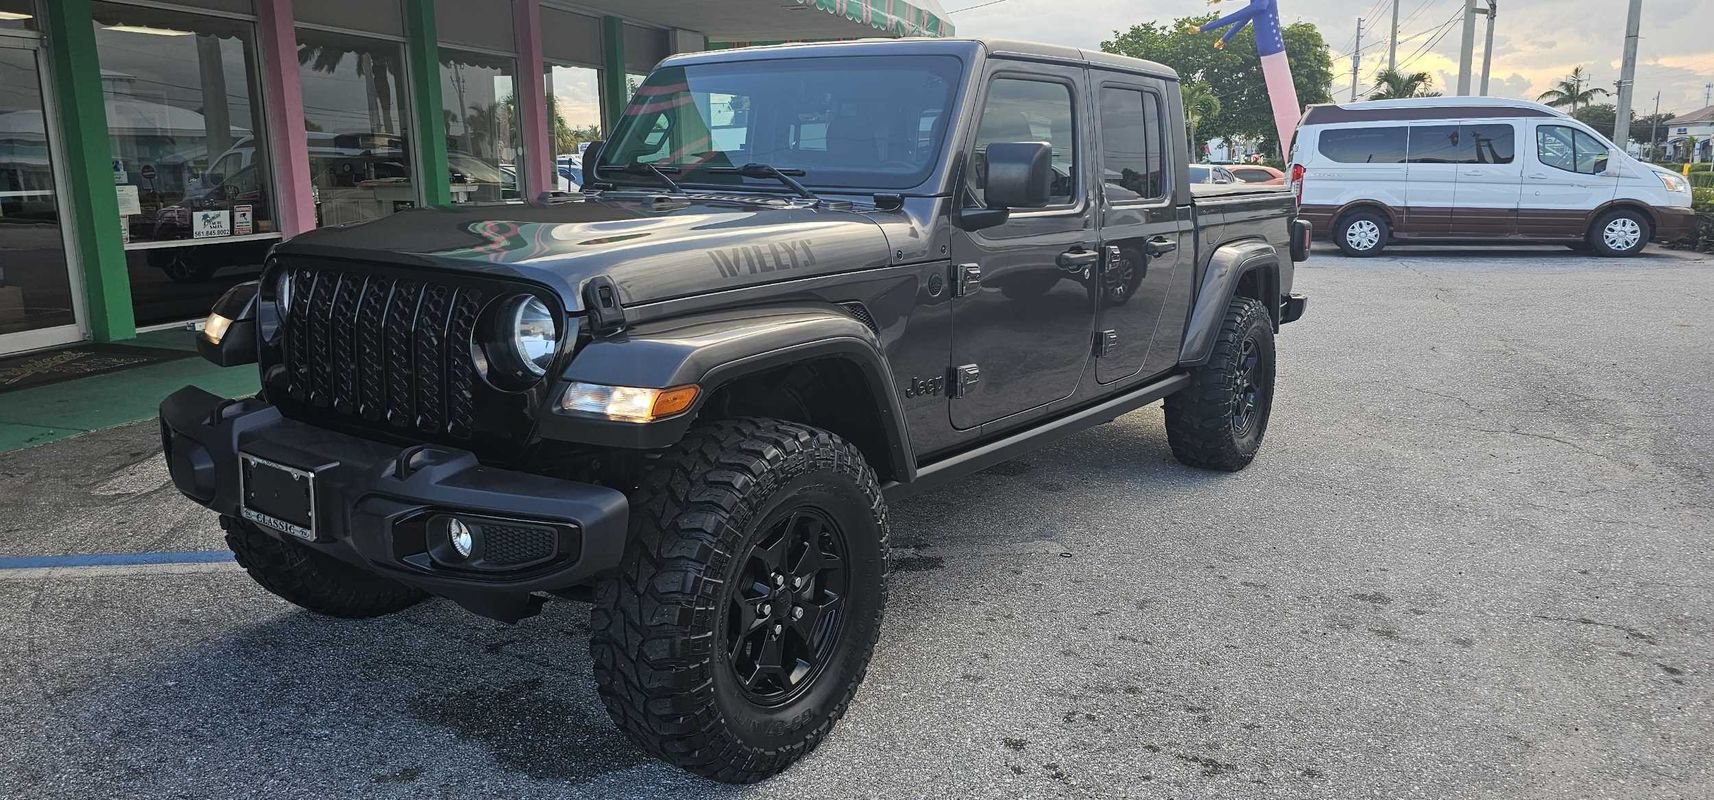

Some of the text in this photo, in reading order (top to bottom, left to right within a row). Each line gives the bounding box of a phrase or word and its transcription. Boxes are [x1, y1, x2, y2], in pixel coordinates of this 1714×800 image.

[706, 239, 816, 278] WILLYS
[905, 376, 943, 399] Jeep
[256, 513, 295, 534] CLASSIC
